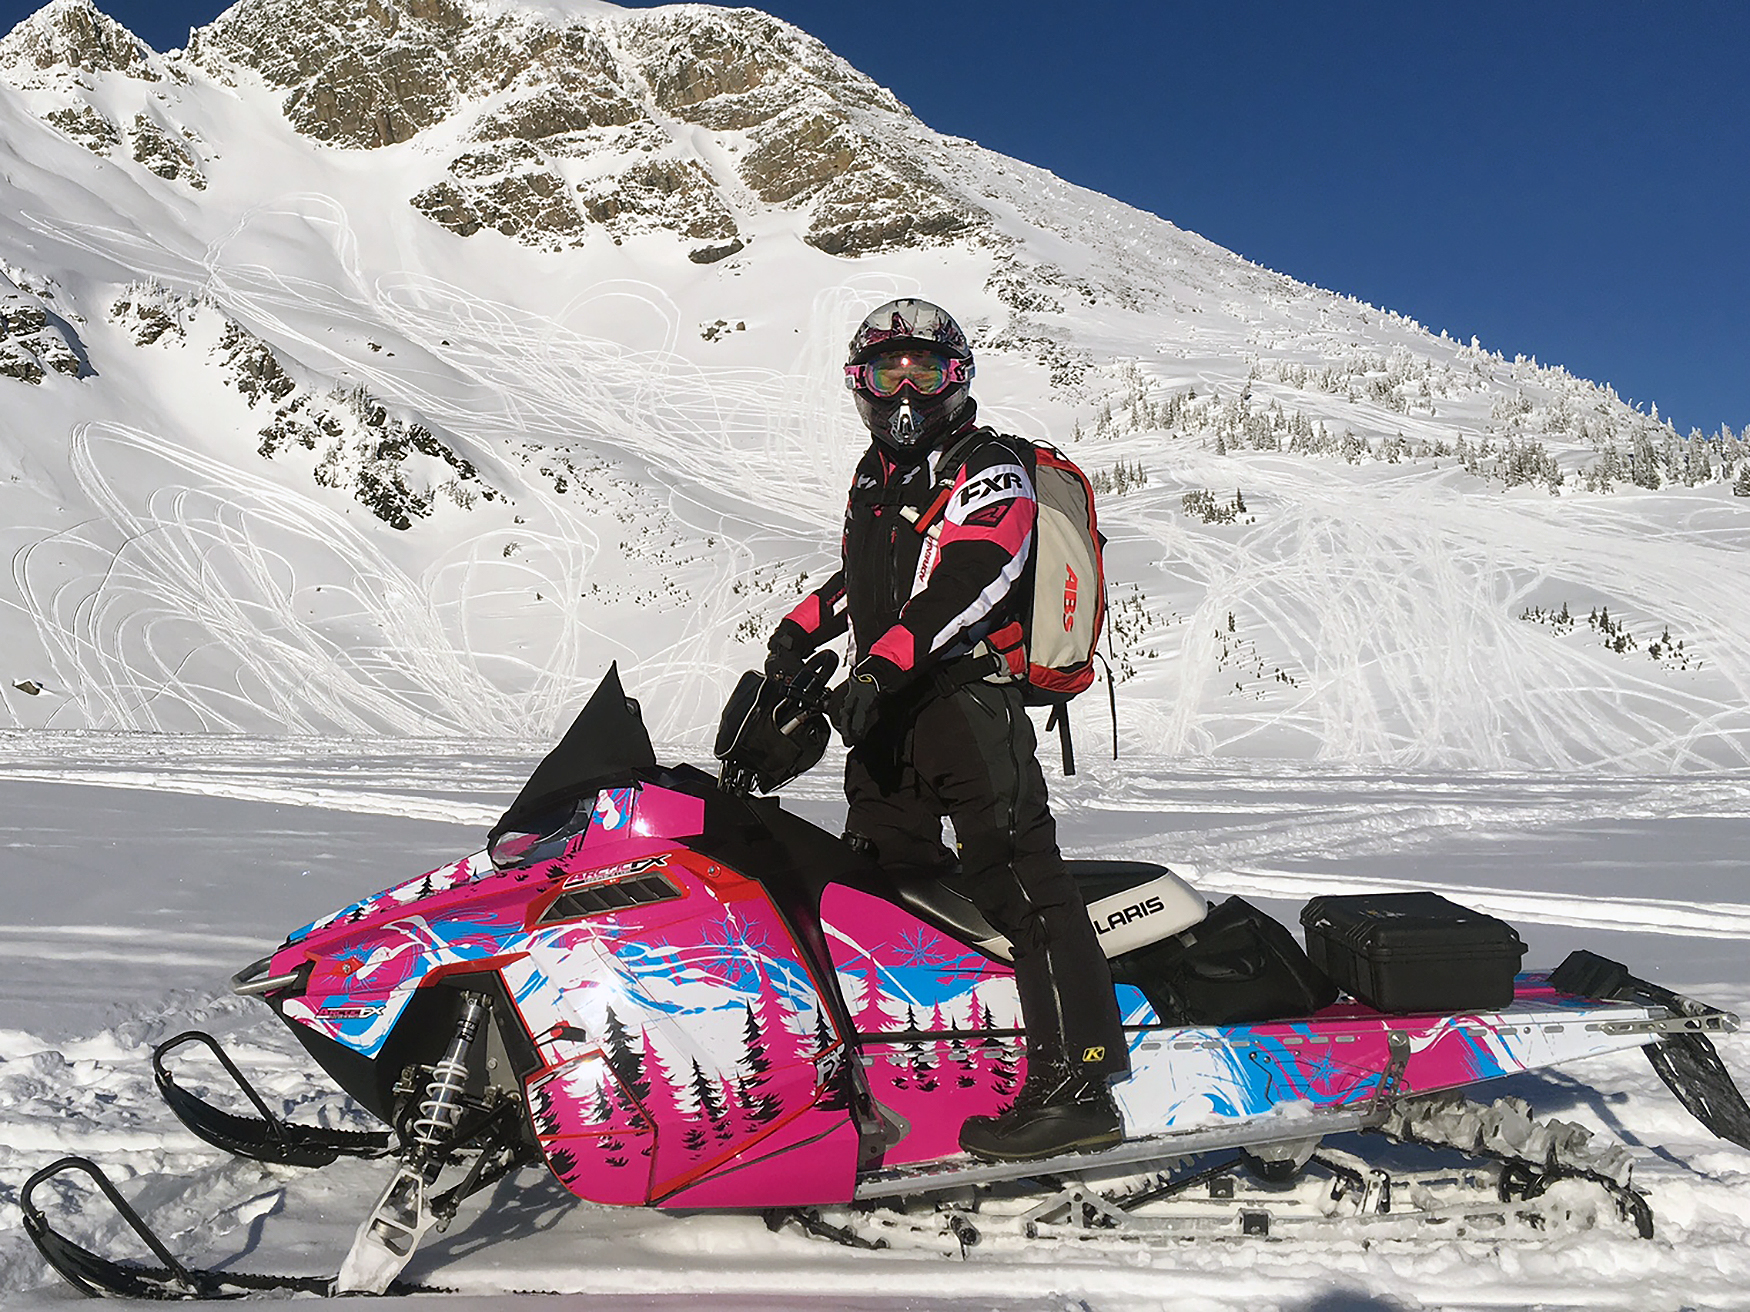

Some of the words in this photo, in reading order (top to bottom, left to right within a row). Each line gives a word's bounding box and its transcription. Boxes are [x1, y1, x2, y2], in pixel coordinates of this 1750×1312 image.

[955, 472, 1023, 508] FXR
[1063, 562, 1079, 633] ABS
[1093, 896, 1165, 935] LARIS
